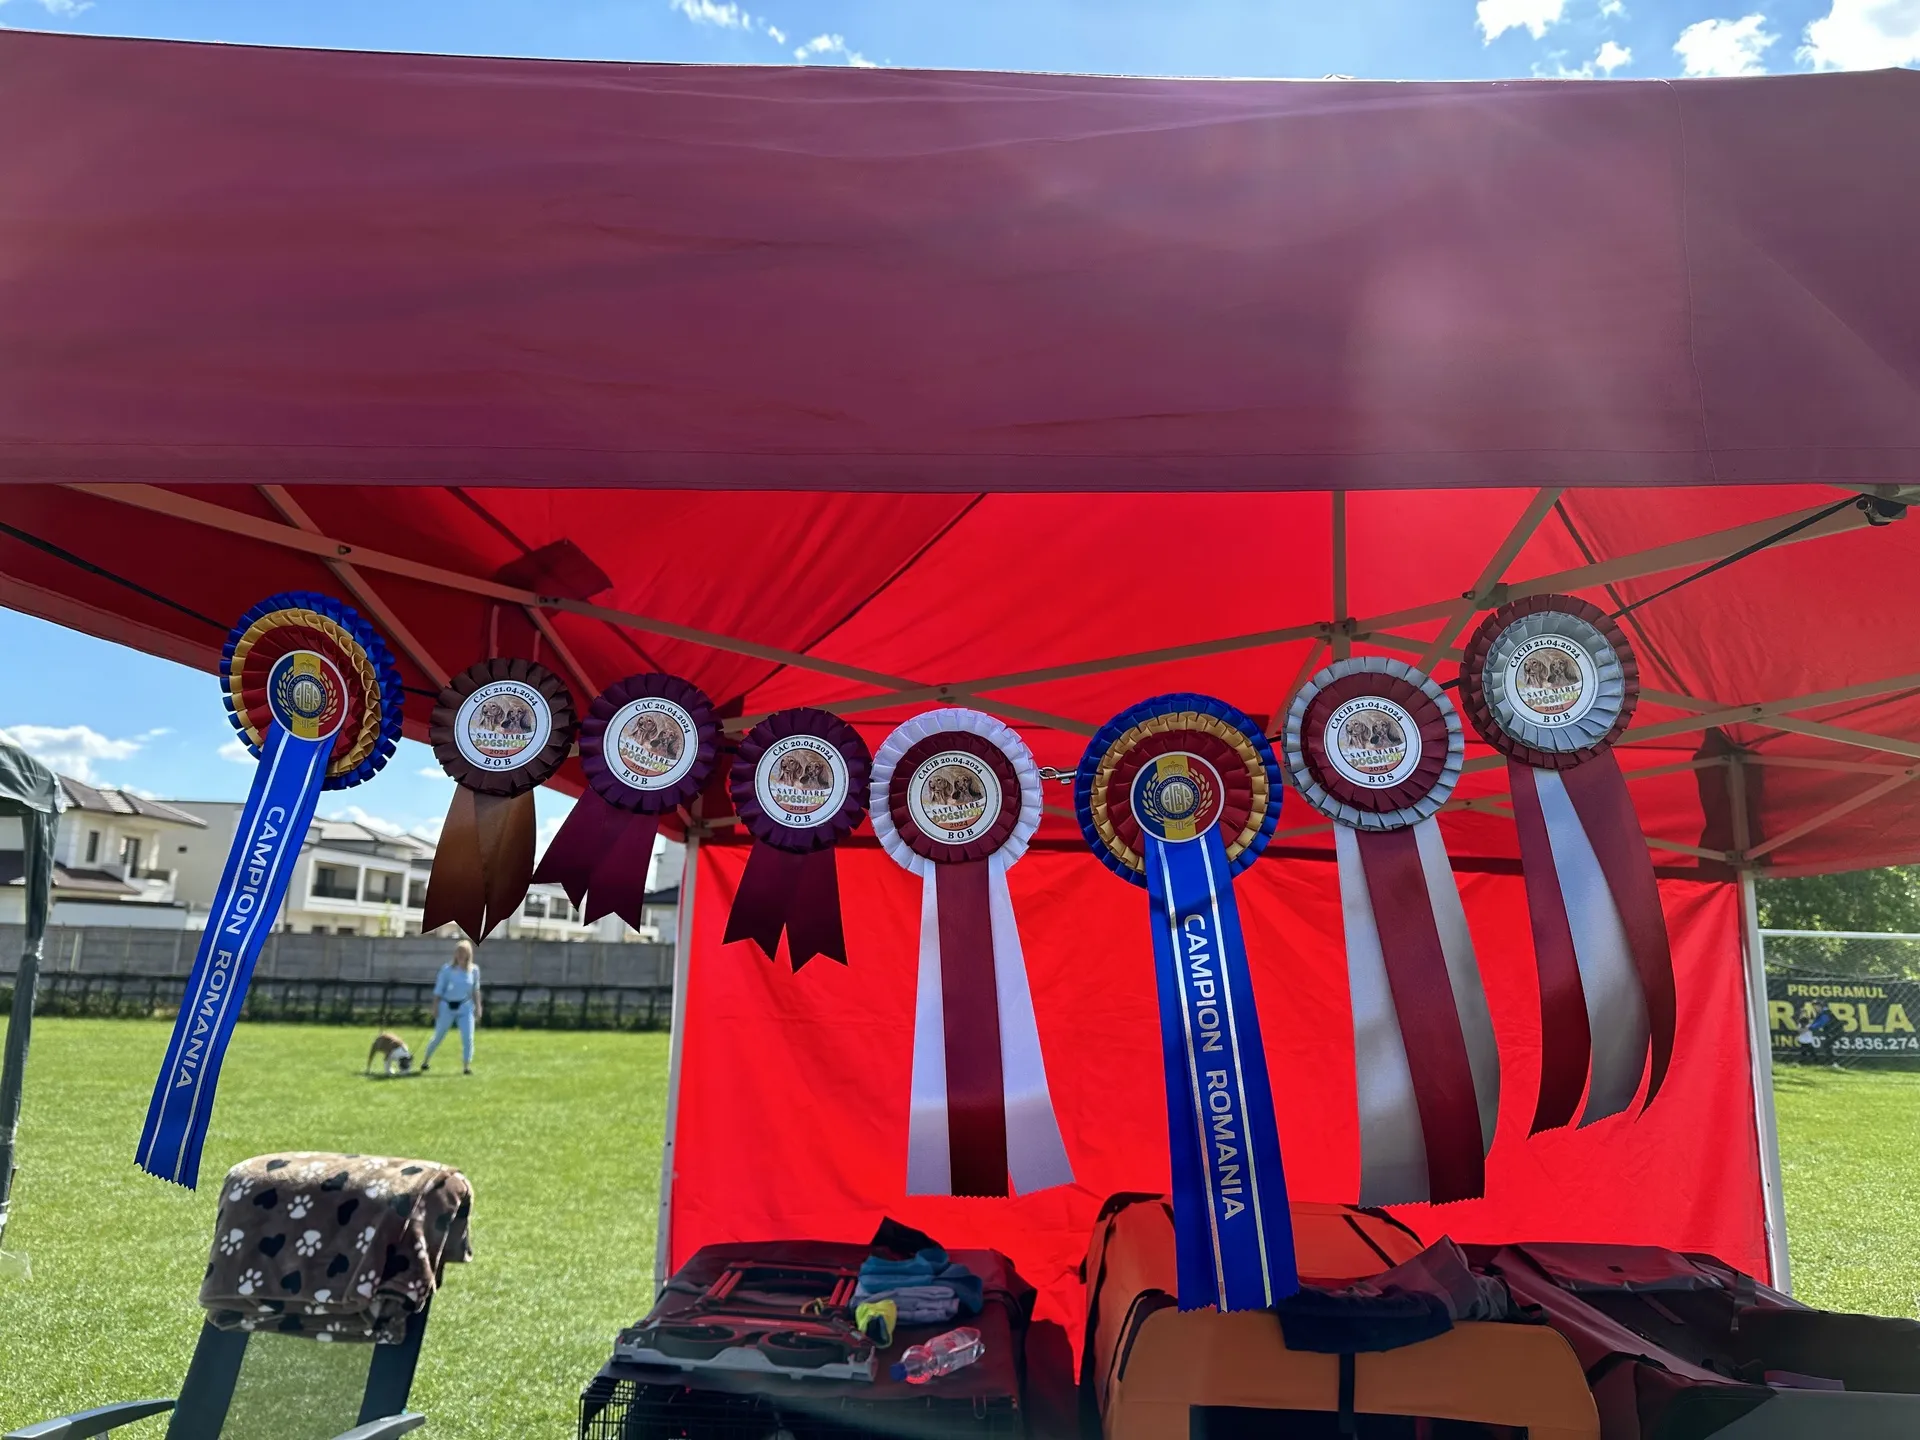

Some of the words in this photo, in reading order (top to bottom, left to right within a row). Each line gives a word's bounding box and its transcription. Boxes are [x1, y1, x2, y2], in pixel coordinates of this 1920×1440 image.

[1510, 643, 1533, 668] CACIB
[1534, 639, 1581, 659] 21.04.2024
[473, 688, 492, 703] CAC
[493, 686, 539, 706] 21.04.2024
[1527, 690, 1549, 699] SATU
[1552, 686, 1576, 694] MARE
[1527, 692, 1579, 706] DOGSHOW
[635, 701, 653, 712] CAC
[655, 703, 691, 734] 20.04.2024
[1331, 706, 1354, 730] CACIB
[1354, 701, 1404, 722] 21.04.2024
[1543, 712, 1571, 723] BOB
[475, 739, 528, 748] DOGSHOW
[772, 743, 790, 756] CAC
[791, 741, 834, 760] 20.04.2024
[620, 747, 669, 772] DOGSHOW
[625, 742, 646, 755] SATU
[647, 752, 671, 765] MARE
[1350, 750, 1373, 759] SATU
[1375, 747, 1400, 756] MARE
[1351, 753, 1403, 767] DOGSHOW
[484, 757, 512, 767] BOB
[630, 763, 649, 775] 2024
[918, 759, 940, 780] CACIB
[940, 757, 983, 775] 20.04.2024
[622, 769, 648, 785] BOB
[1368, 773, 1395, 783] BOS
[776, 794, 826, 804] DOGSHOW
[777, 788, 800, 796] SATU
[801, 789, 825, 797] MARE
[932, 807, 954, 815] SATU
[956, 802, 980, 811] MARE
[932, 808, 983, 822] DOGSHOW
[785, 814, 811, 823] BOB
[948, 828, 974, 839] BOB
[226, 806, 285, 936] CAMPION
[1787, 983, 1888, 998] PROGRAMUL
[175, 949, 231, 1089] ROMANIA
[1183, 913, 1223, 1053] CAMPION
[1206, 1068, 1245, 1220] ROMANIA
